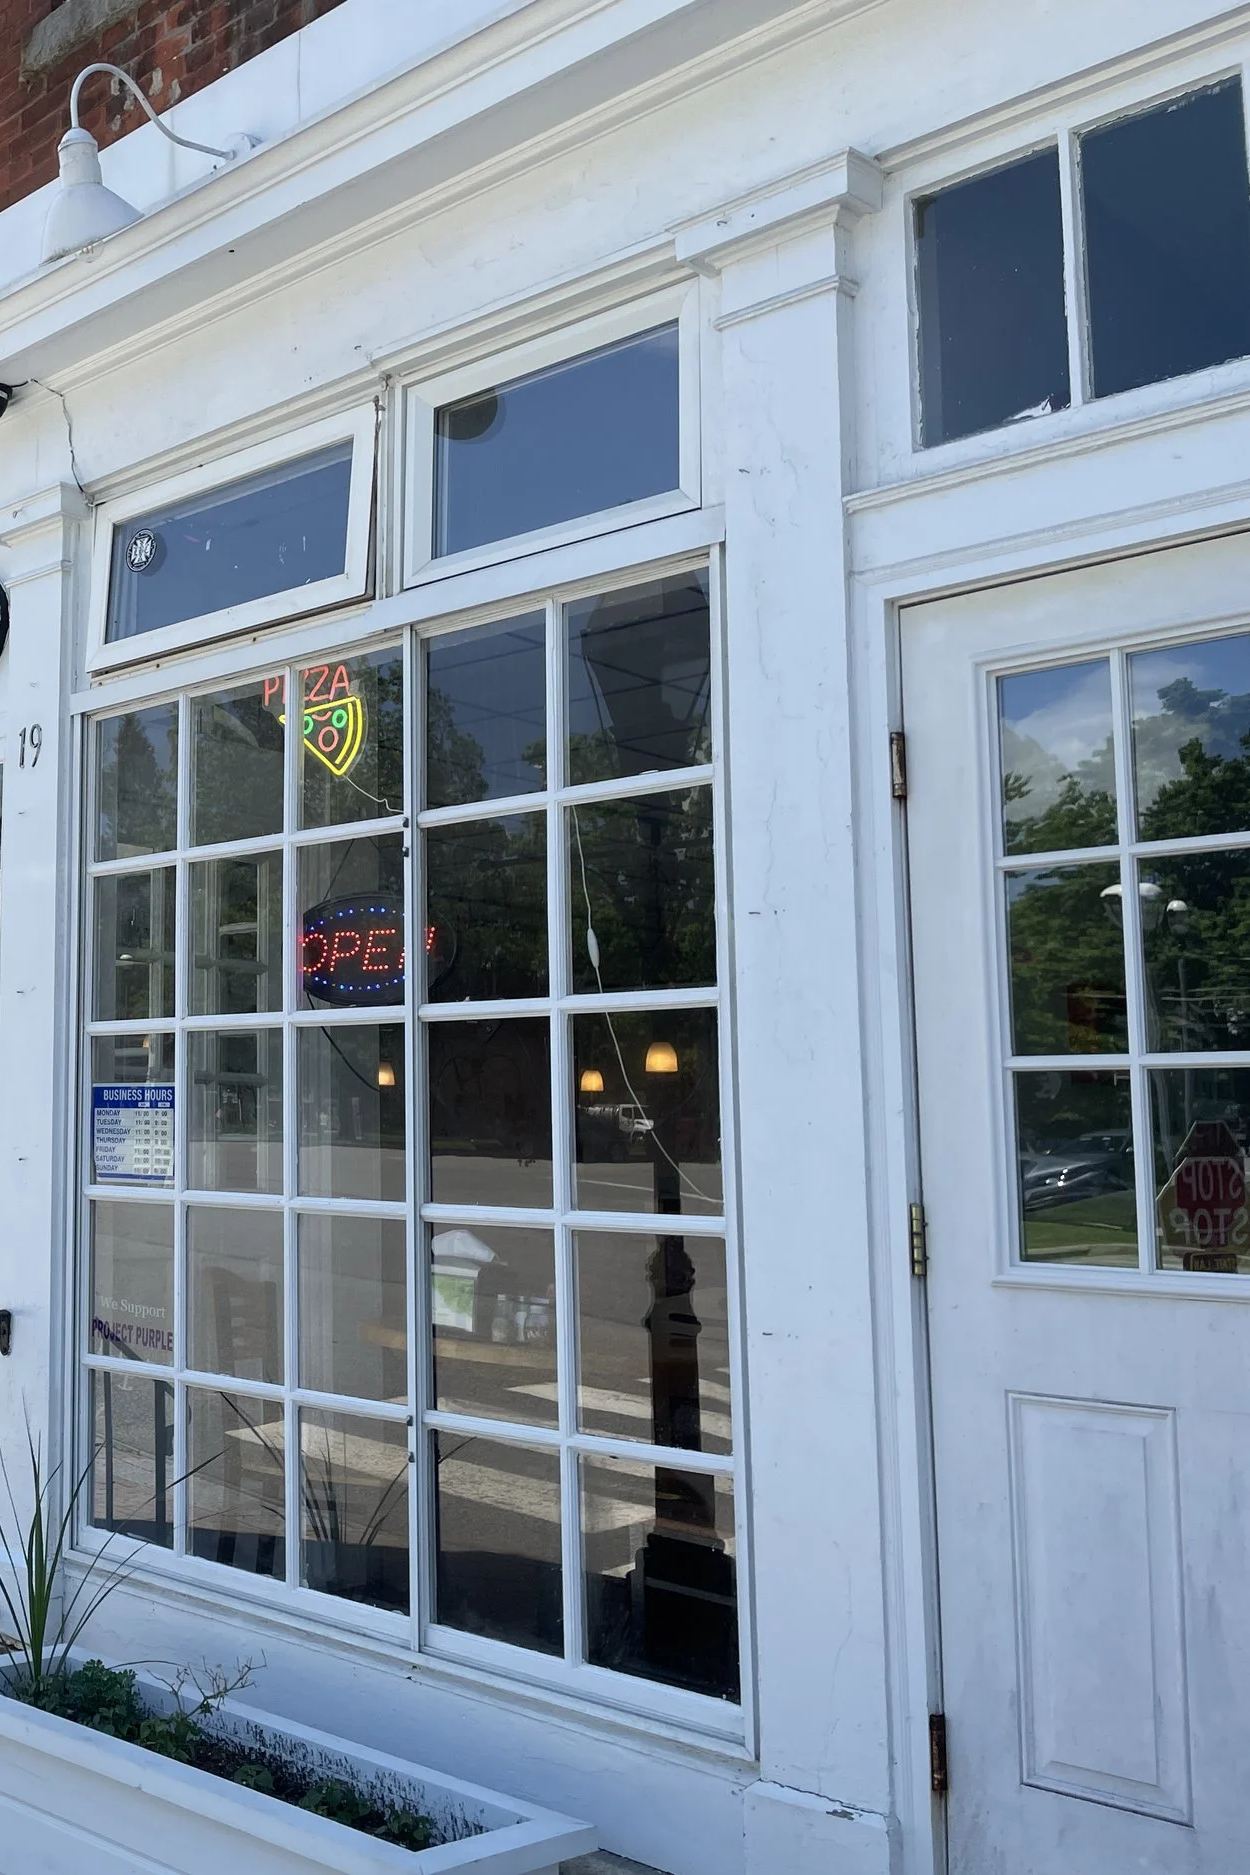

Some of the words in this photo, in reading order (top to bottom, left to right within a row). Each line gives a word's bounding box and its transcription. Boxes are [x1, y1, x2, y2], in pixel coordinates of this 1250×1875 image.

[18, 722, 43, 769] 19
[103, 1089, 143, 1101] BUSINESS
[144, 1089, 173, 1101] HOURS
[96, 1109, 121, 1117] MONDAY
[96, 1136, 126, 1144] THURSDAY
[95, 1145, 116, 1153] FRIDAY
[95, 1155, 125, 1163] SATURDAY
[95, 1164, 119, 1172] SUNDAY
[100, 1296, 118, 1310] We
[120, 1298, 167, 1318] Support
[91, 1317, 134, 1344] PROJECT
[136, 1326, 174, 1352] PURPLE
